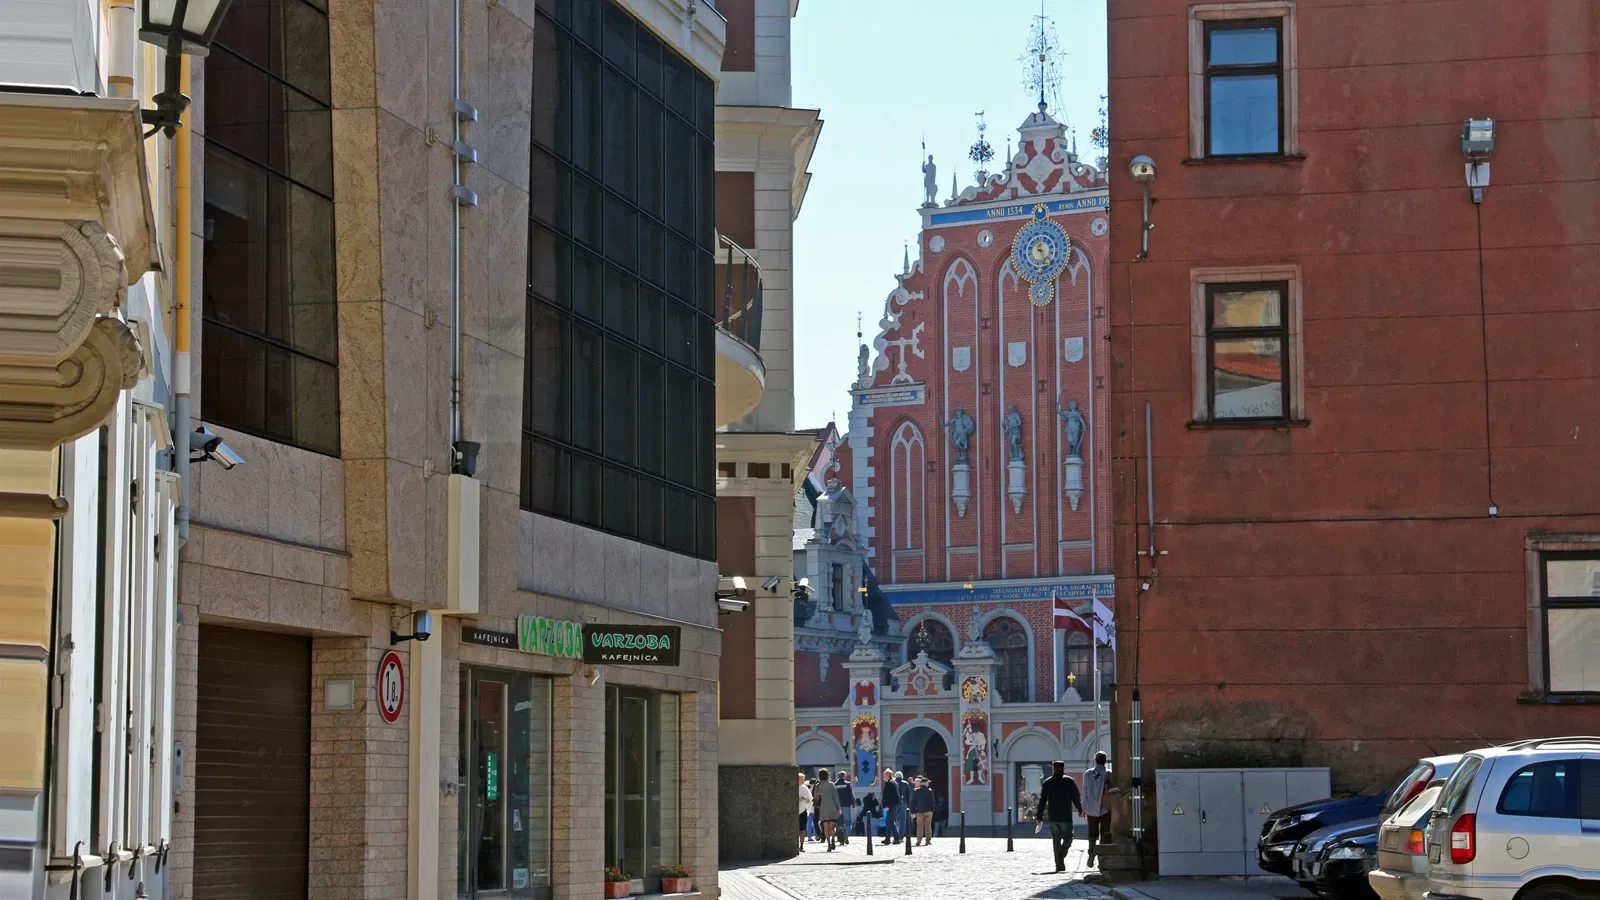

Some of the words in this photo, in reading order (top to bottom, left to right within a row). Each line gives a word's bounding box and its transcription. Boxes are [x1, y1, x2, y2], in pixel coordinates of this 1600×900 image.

[1076, 198, 1096, 208] ANNO
[986, 207, 1005, 218] ANNO
[1007, 206, 1023, 216] 1334
[518, 613, 583, 659] VARZOBA
[591, 632, 671, 650] VARZOBA
